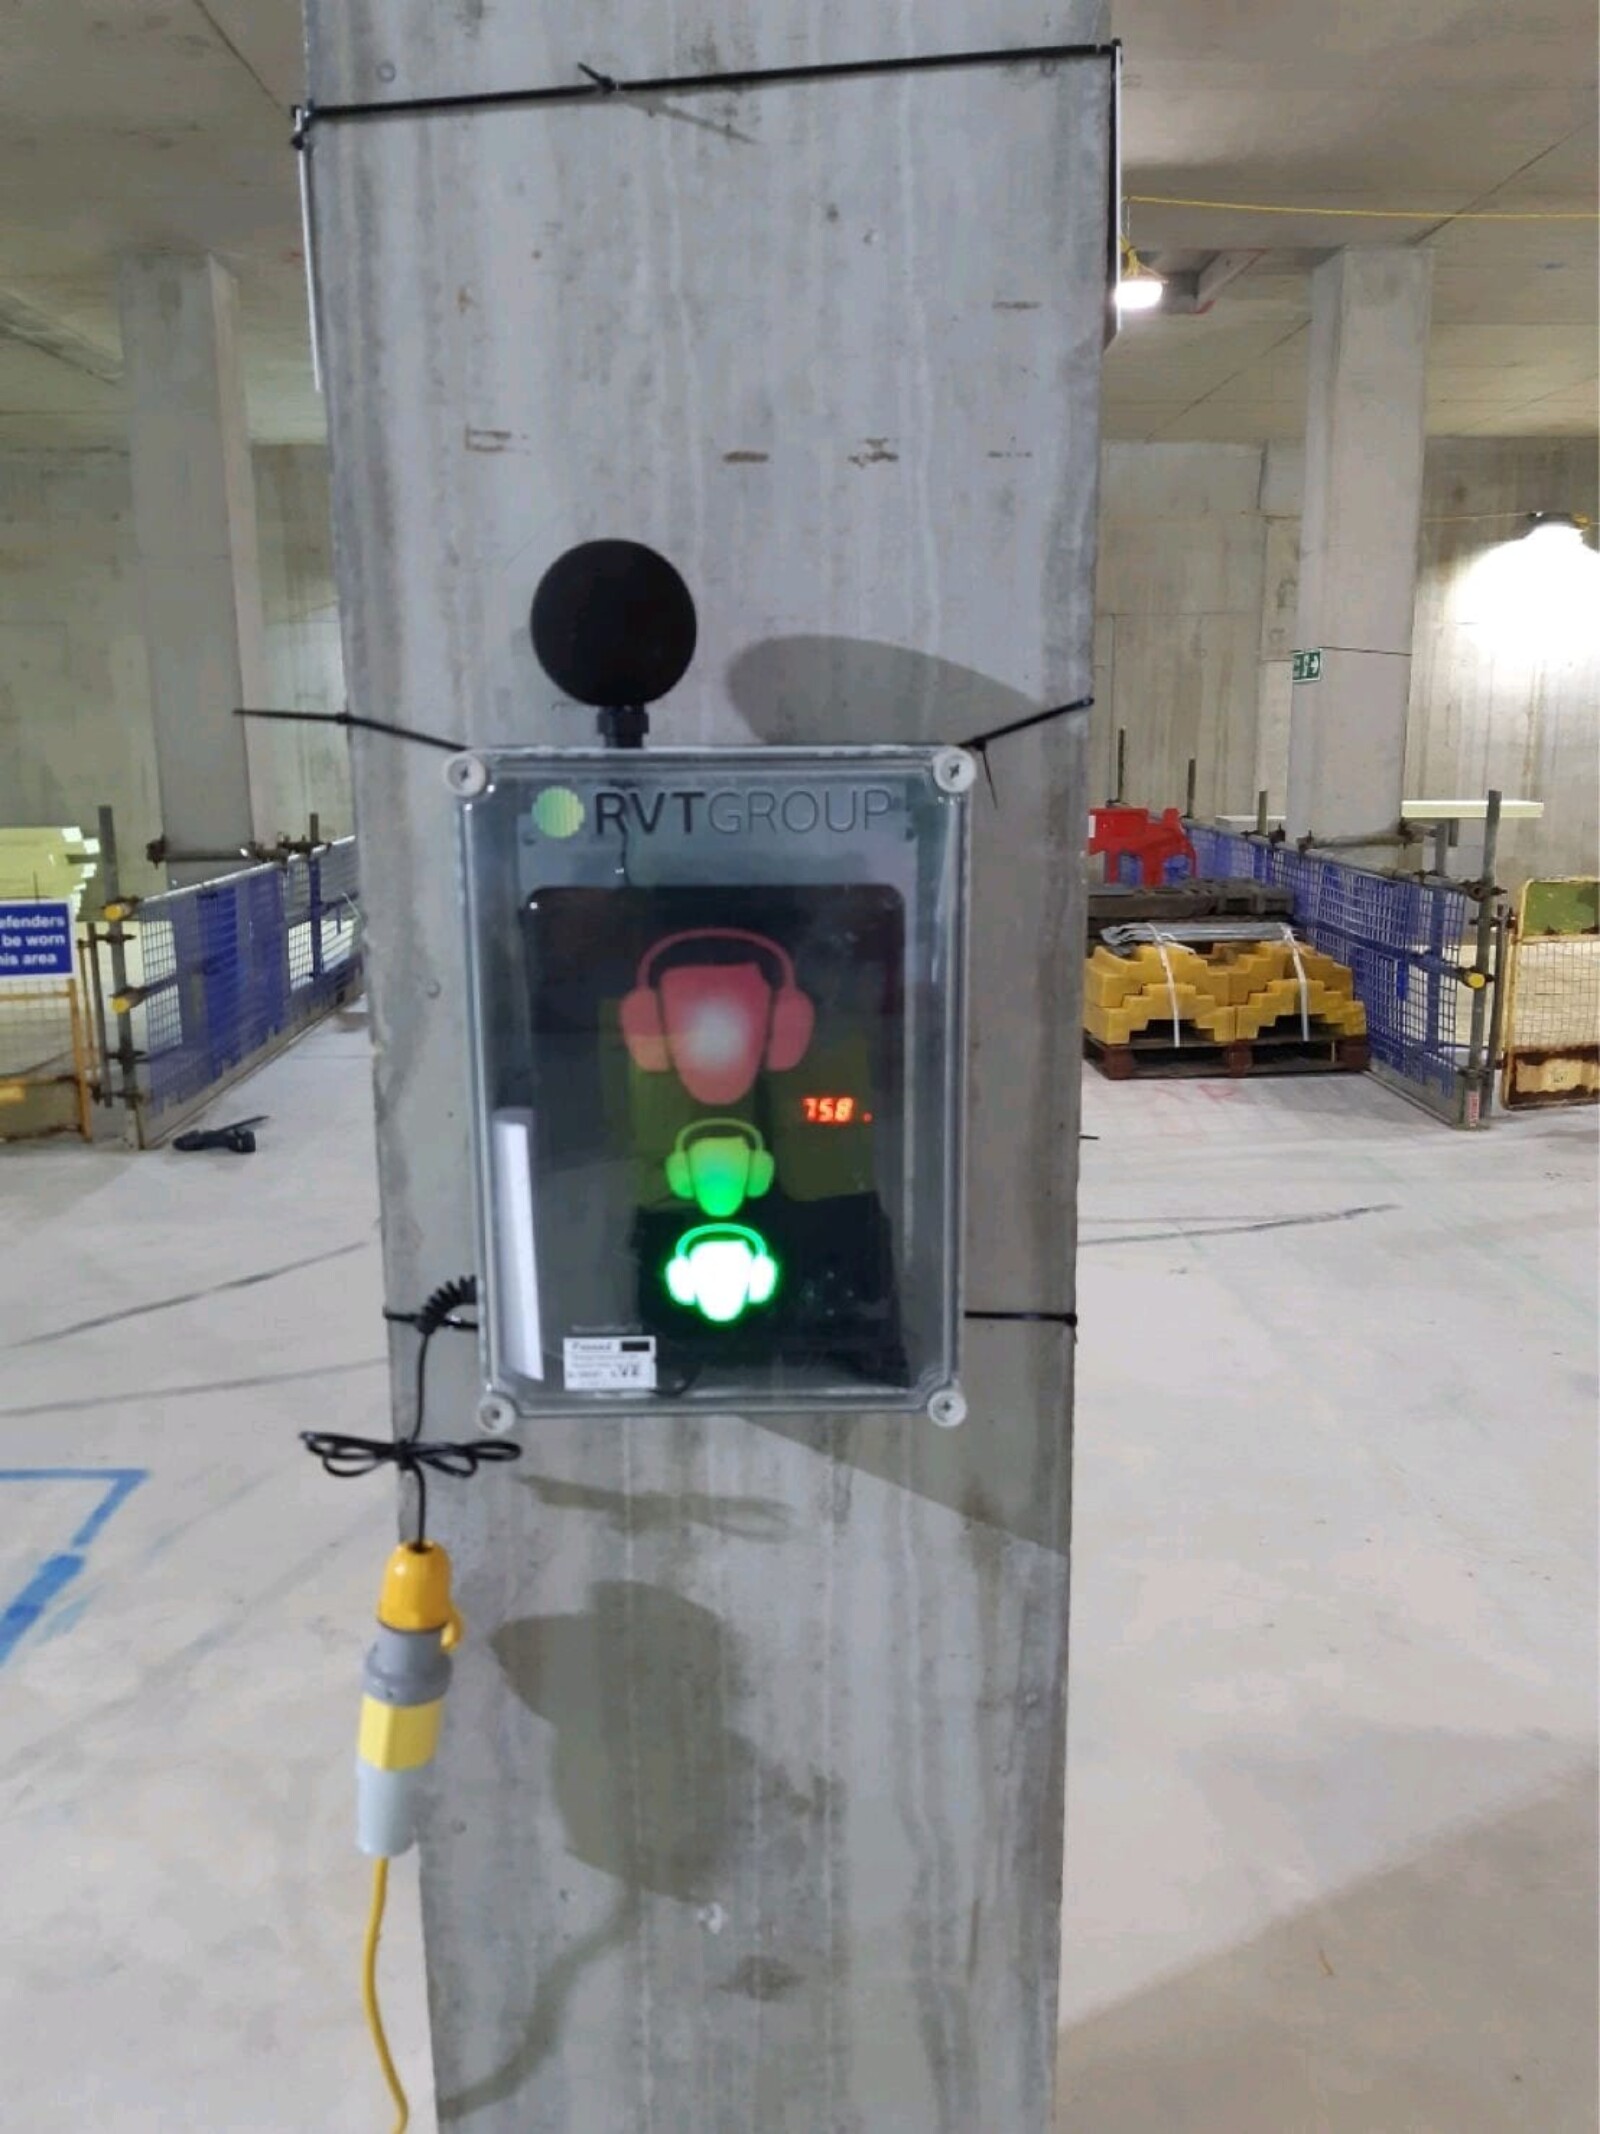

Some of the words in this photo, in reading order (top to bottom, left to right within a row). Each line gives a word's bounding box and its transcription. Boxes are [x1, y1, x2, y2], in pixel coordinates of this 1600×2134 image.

[2, 934, 21, 947] be
[26, 935, 65, 946] worn
[24, 954, 57, 965] area
